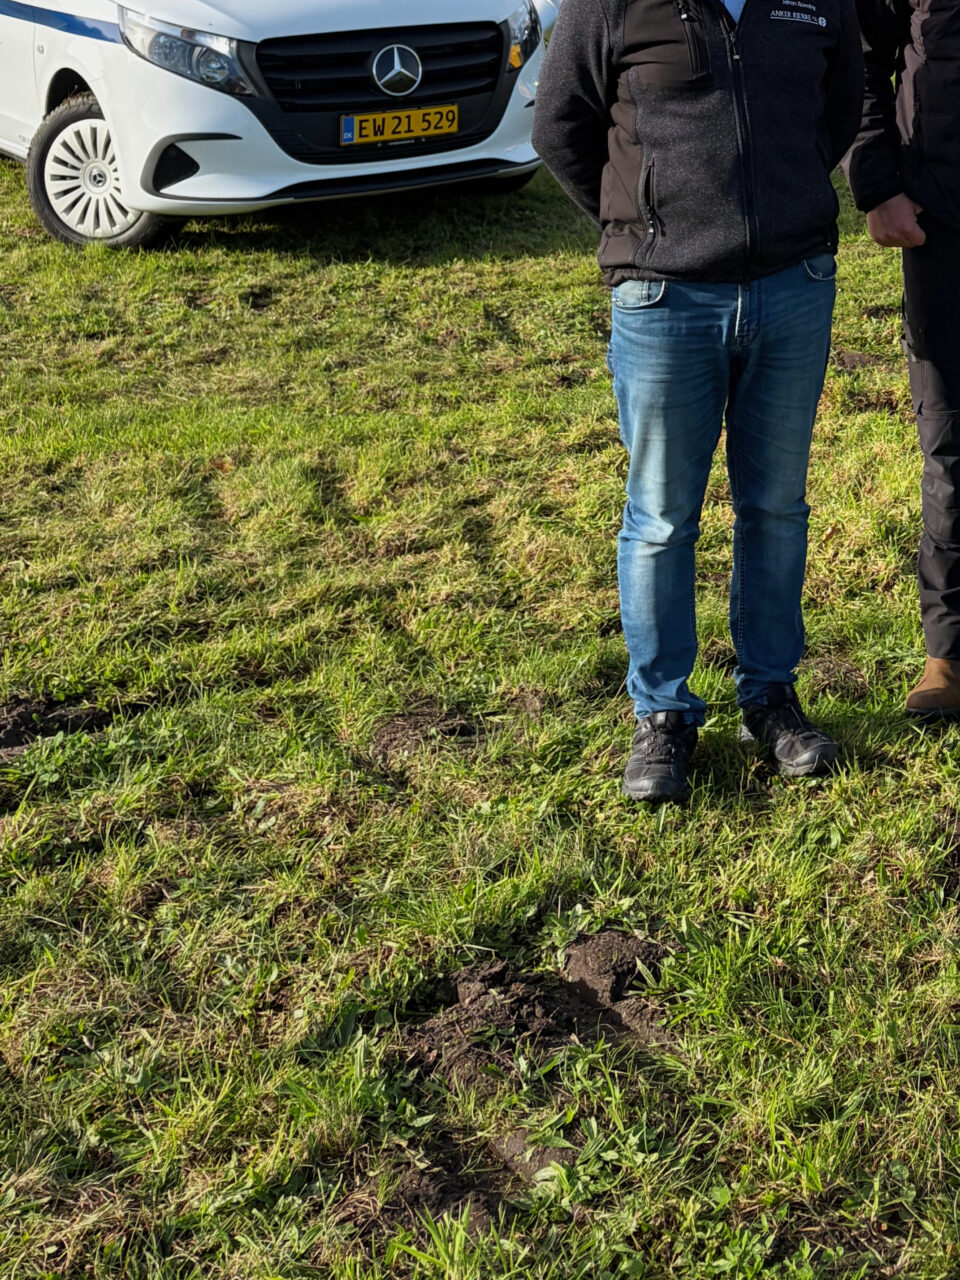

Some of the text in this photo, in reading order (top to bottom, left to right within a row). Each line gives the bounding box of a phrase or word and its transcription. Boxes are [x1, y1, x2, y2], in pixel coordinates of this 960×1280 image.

[358, 109, 456, 139] EW 21 529
[343, 131, 353, 139] DK
